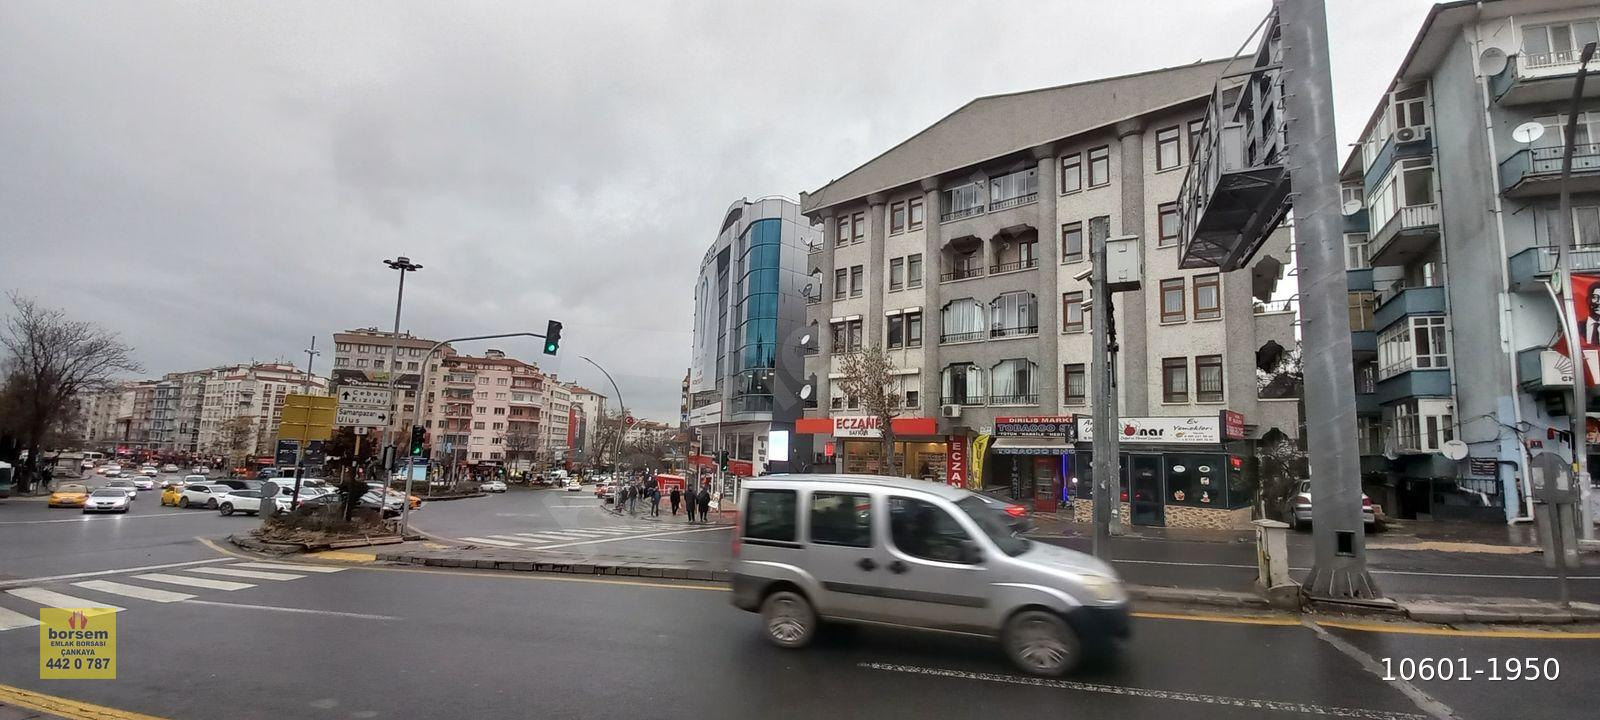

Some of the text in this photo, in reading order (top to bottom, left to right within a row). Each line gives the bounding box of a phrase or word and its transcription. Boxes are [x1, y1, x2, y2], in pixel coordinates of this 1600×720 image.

[337, 416, 361, 424] Ulus
[836, 417, 882, 429] ECZANE
[997, 424, 1056, 432] TOBACCO
[1139, 428, 1164, 437] nar
